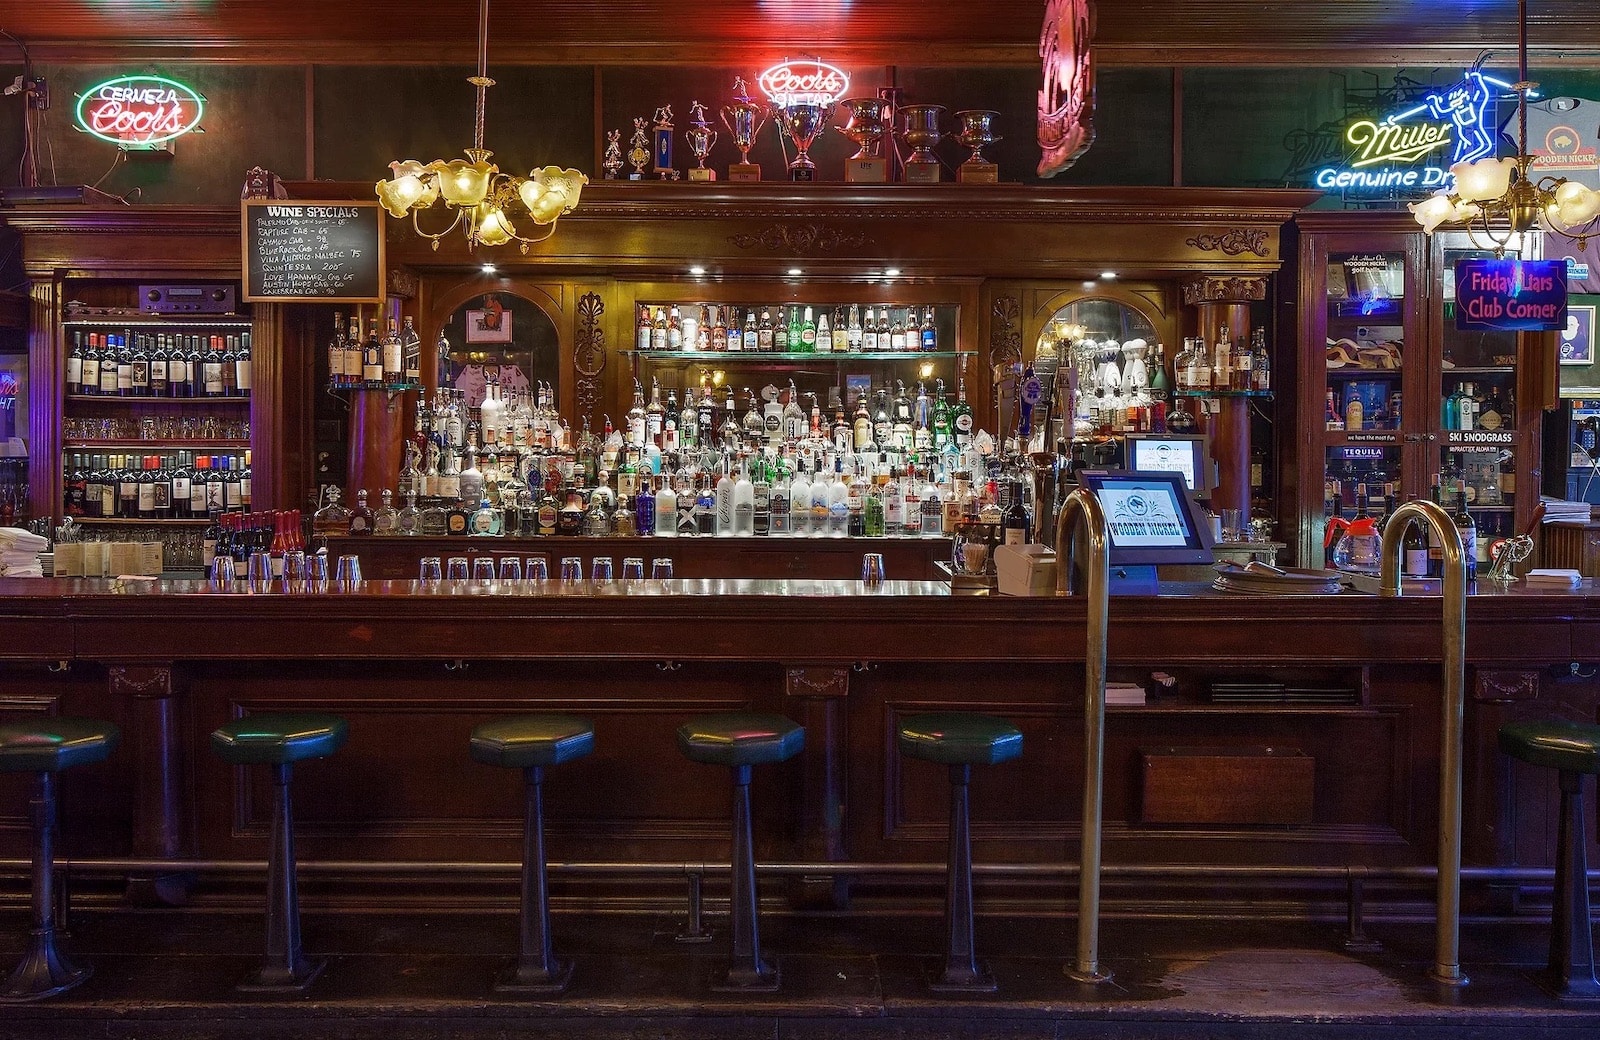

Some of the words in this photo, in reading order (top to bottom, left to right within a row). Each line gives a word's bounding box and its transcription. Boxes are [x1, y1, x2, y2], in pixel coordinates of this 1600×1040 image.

[765, 67, 842, 93] Coors
[100, 86, 180, 105] CERVEZA
[91, 101, 182, 132] Coors
[1347, 121, 1453, 159] Miller
[1317, 167, 1418, 188] Genuine
[266, 206, 303, 217] WINE
[306, 207, 359, 218] SPECIALS
[262, 263, 312, 272] QUINTESSA
[1351, 267, 1365, 275] golf
[263, 273, 285, 281] LOVE
[287, 273, 324, 281] HAMMER
[1471, 271, 1516, 298] Friday
[1519, 271, 1554, 293] Liars
[1468, 296, 1503, 318] Club
[1505, 298, 1558, 319] Corner
[1449, 432, 1462, 442] SKI
[1463, 433, 1513, 442] SNODGRASS
[1344, 448, 1382, 456] TEQUILA
[1109, 522, 1148, 537] WOODEN
[1147, 522, 1181, 537] NICKEL
